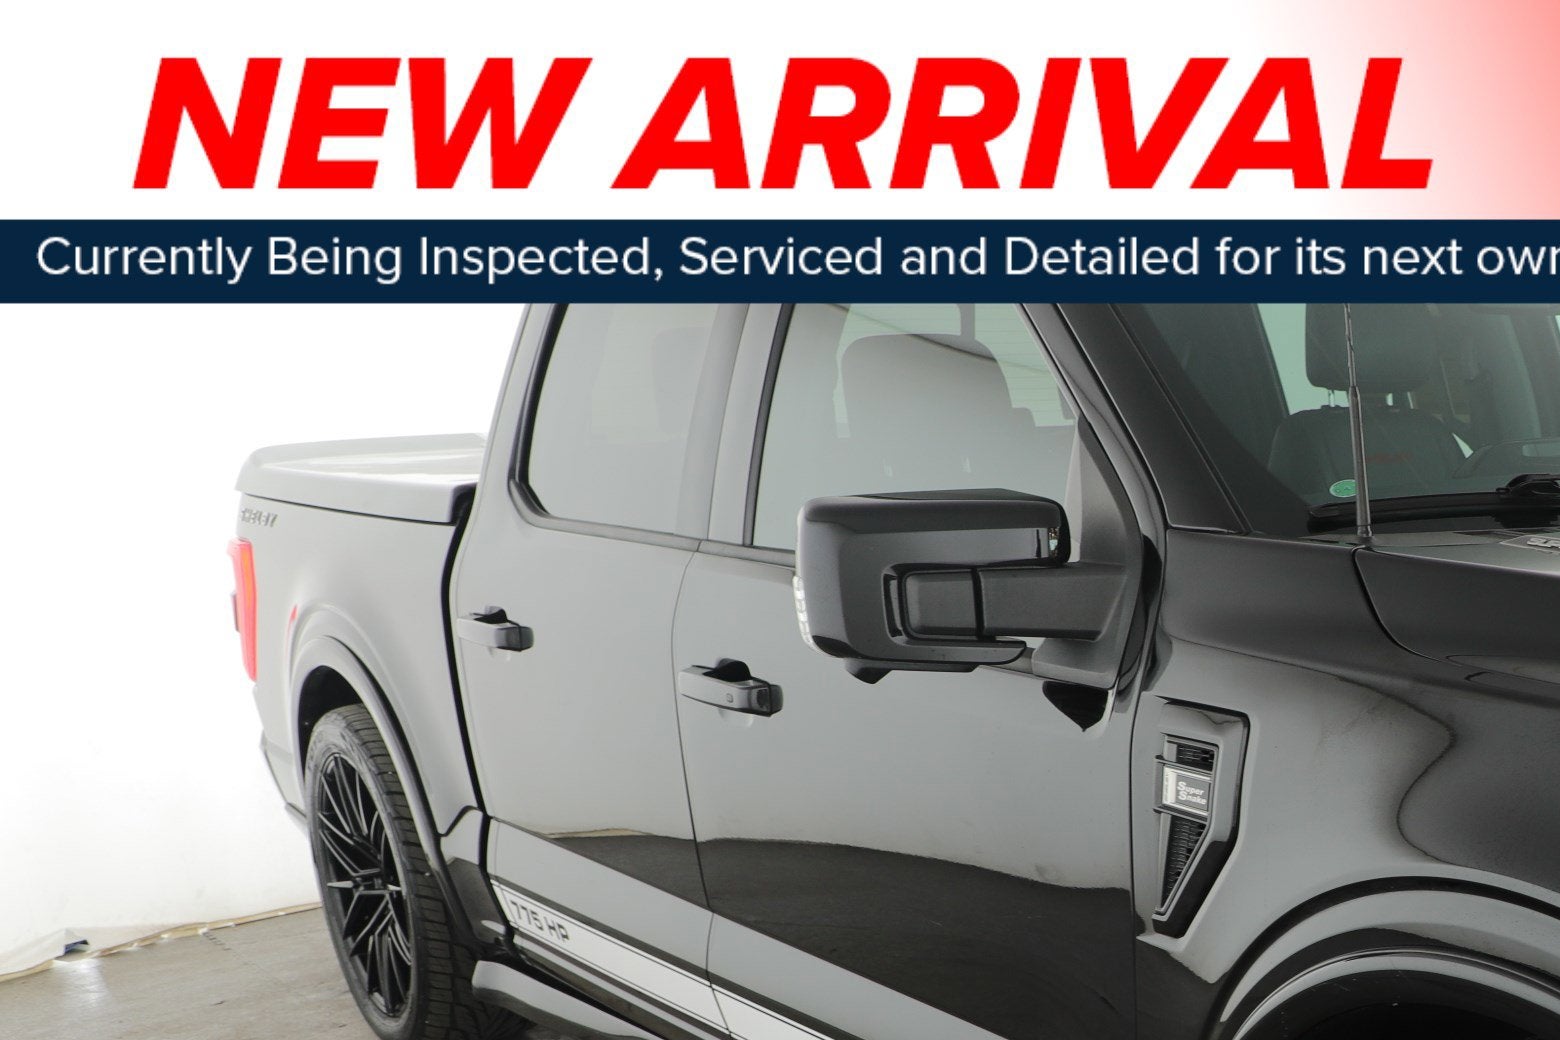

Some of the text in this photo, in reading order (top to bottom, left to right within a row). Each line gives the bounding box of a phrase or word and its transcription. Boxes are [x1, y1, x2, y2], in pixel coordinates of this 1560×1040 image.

[1177, 781, 1204, 795] Super
[1178, 791, 1207, 804] Snake
[510, 900, 570, 943] 775 HP
